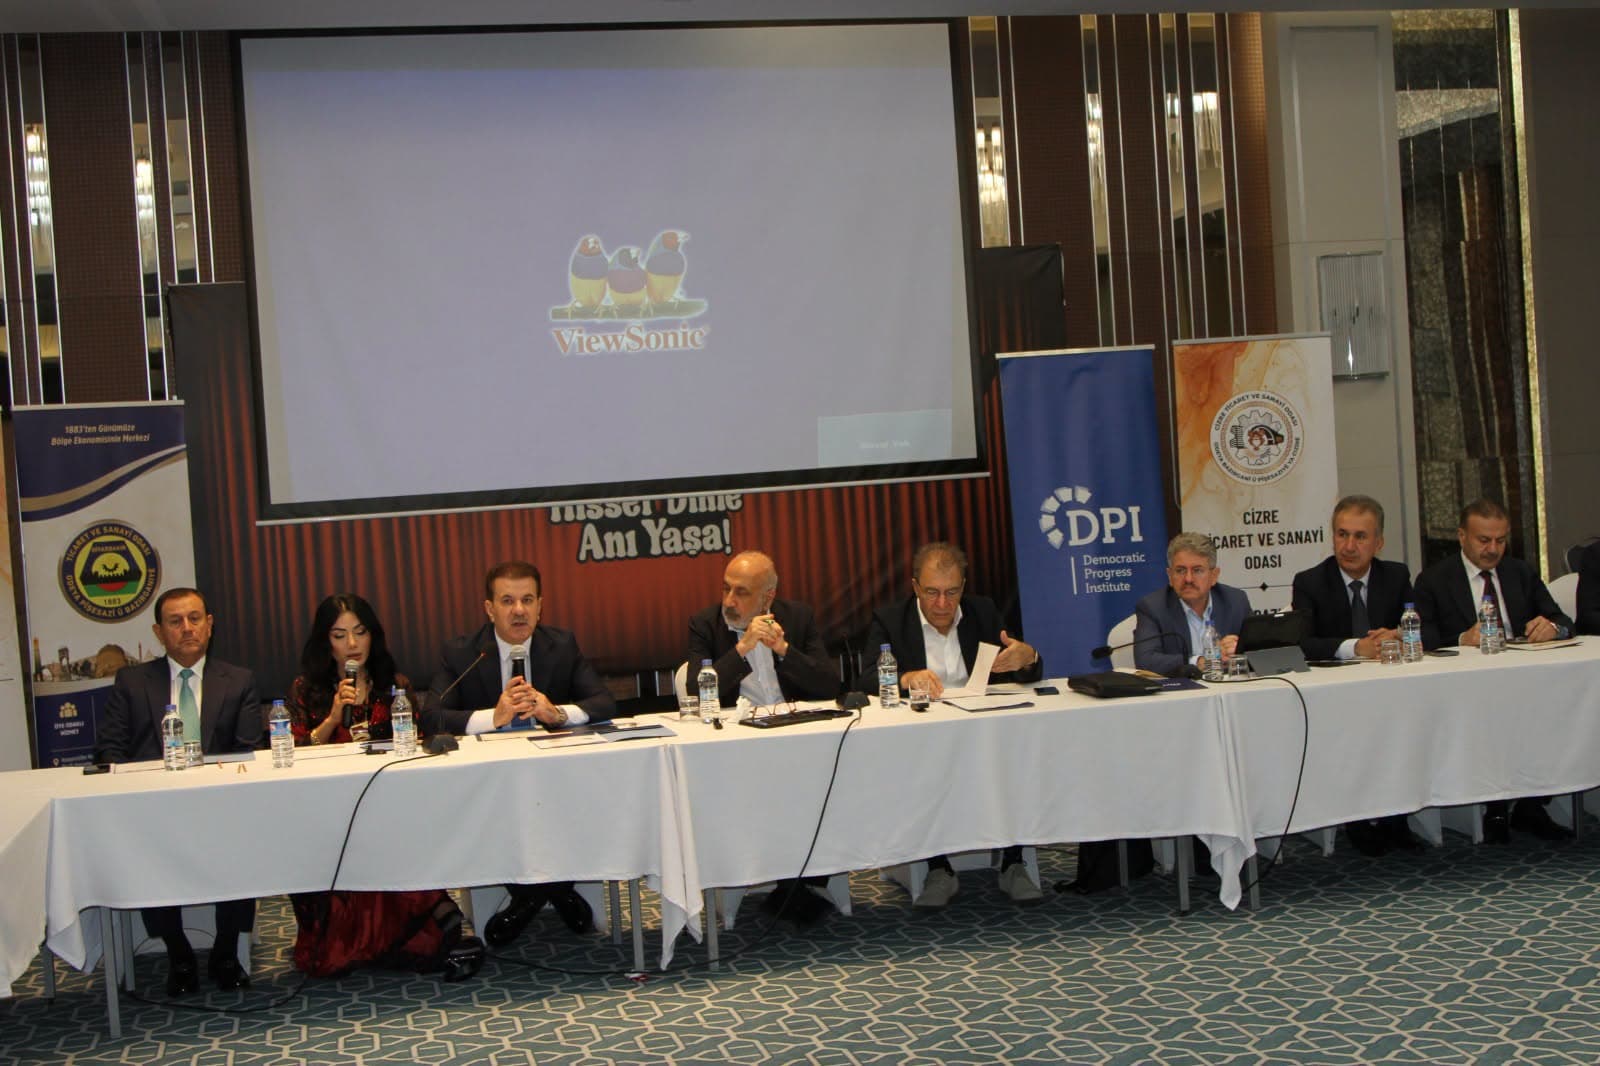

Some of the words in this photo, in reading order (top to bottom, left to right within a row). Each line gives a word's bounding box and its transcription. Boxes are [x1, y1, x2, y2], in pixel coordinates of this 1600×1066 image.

[552, 322, 706, 354] ViewSonic
[1243, 507, 1279, 525] CİZRE
[1066, 506, 1143, 546] DPI
[578, 523, 638, 561] Anı
[641, 517, 732, 555] Yaşa!
[1258, 533, 1274, 547] VE
[1278, 526, 1324, 545] SANAYİ
[1083, 552, 1146, 566] Democratic
[1244, 554, 1282, 570] ODASI
[1084, 568, 1132, 581] Progress
[1085, 582, 1131, 594] Institute
